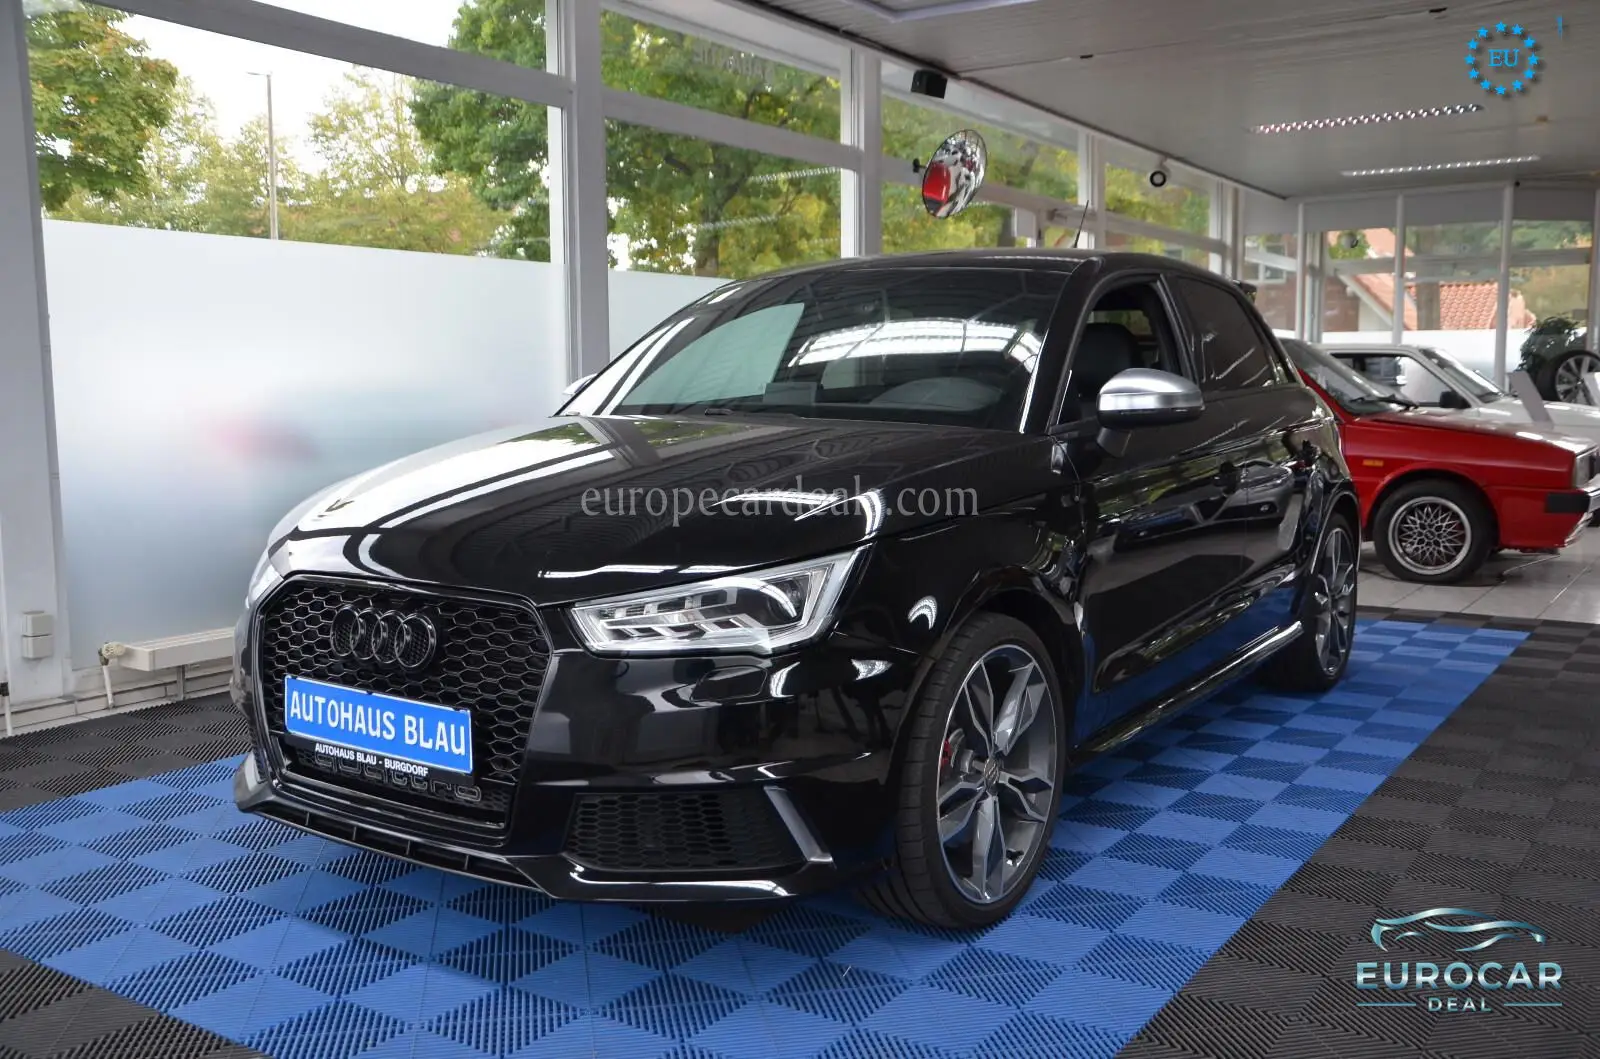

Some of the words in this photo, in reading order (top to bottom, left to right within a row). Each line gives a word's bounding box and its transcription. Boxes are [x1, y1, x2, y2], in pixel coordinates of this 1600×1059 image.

[290, 690, 396, 741] AUTOHAUS
[404, 714, 465, 756] BLAU
[315, 742, 355, 762] AUTOHAUS
[356, 752, 377, 766] BLAU
[384, 758, 429, 777] BURGDORF
